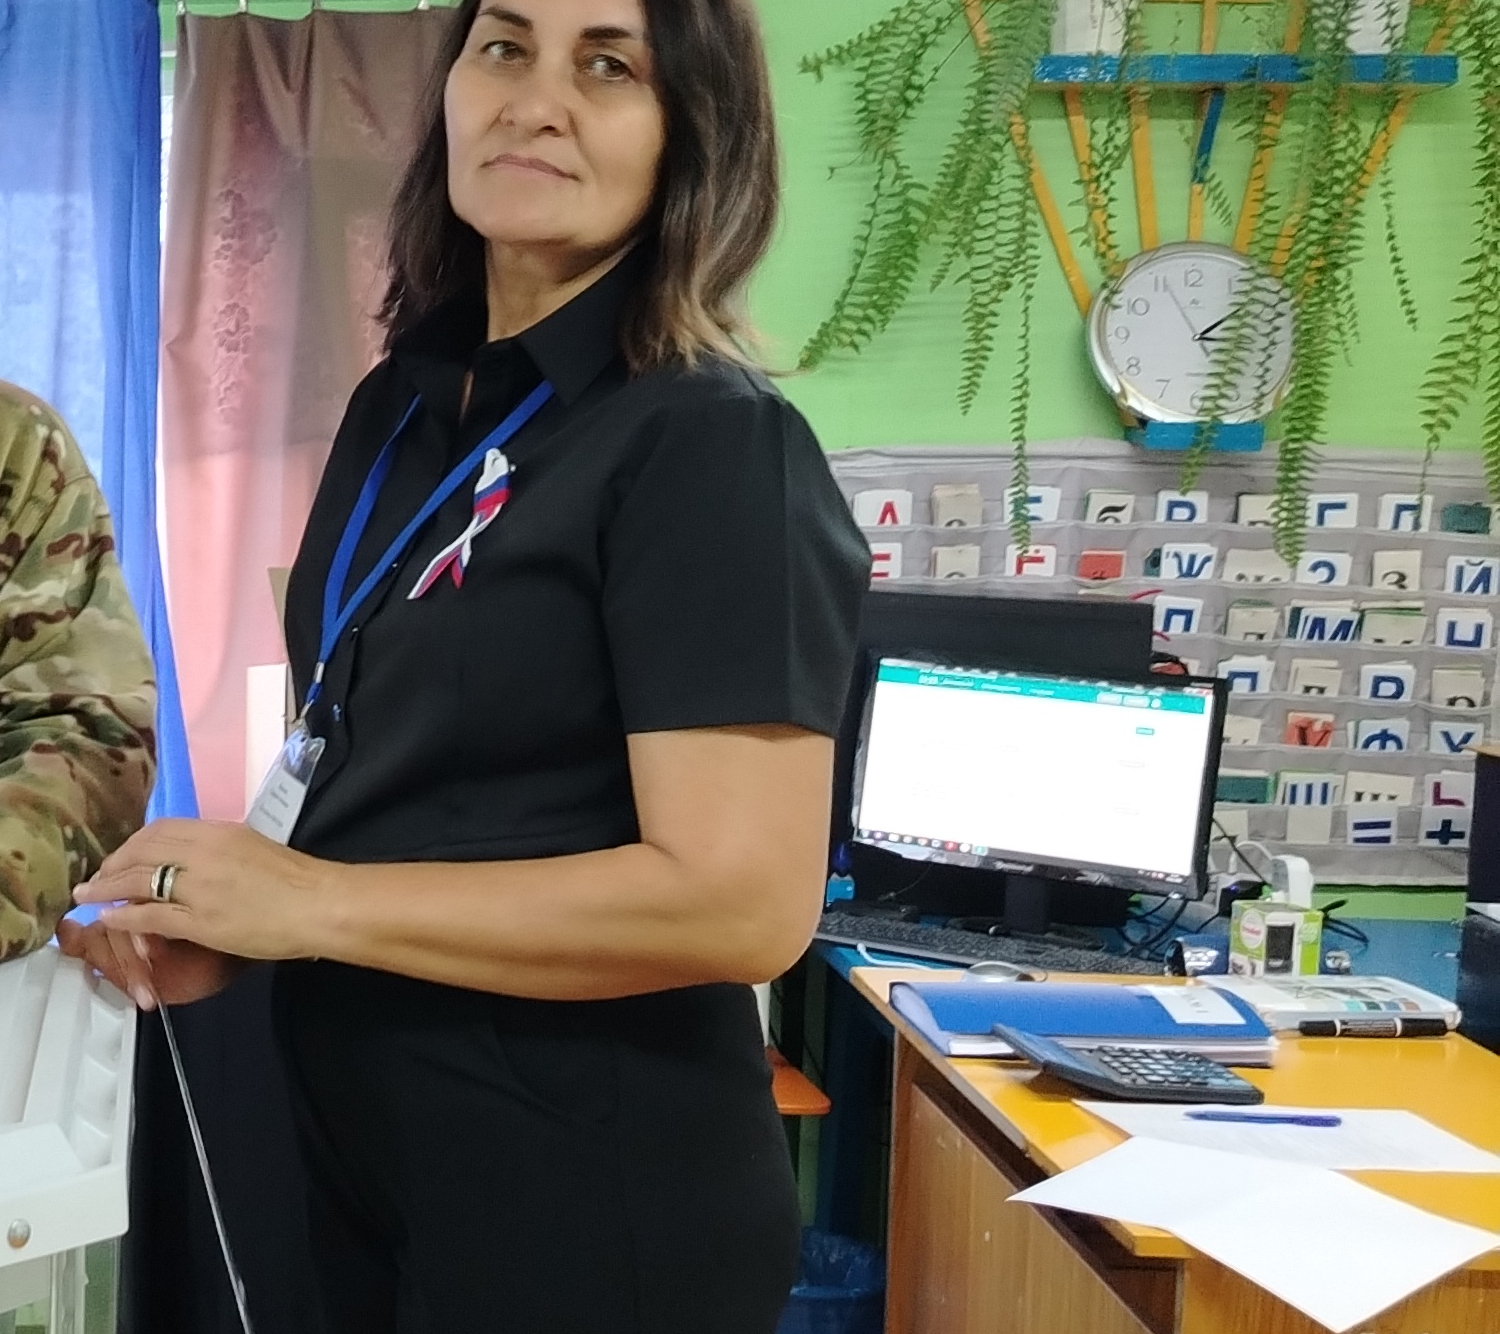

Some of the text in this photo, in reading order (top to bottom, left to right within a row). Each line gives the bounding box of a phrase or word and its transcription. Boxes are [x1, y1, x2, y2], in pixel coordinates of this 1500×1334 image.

[1154, 275, 1169, 293] 11
[1184, 268, 1203, 287] 12
[1127, 297, 1150, 316] 10
[1114, 325, 1130, 345] 9
[1126, 356, 1141, 376] 8
[1155, 378, 1171, 399] 7
